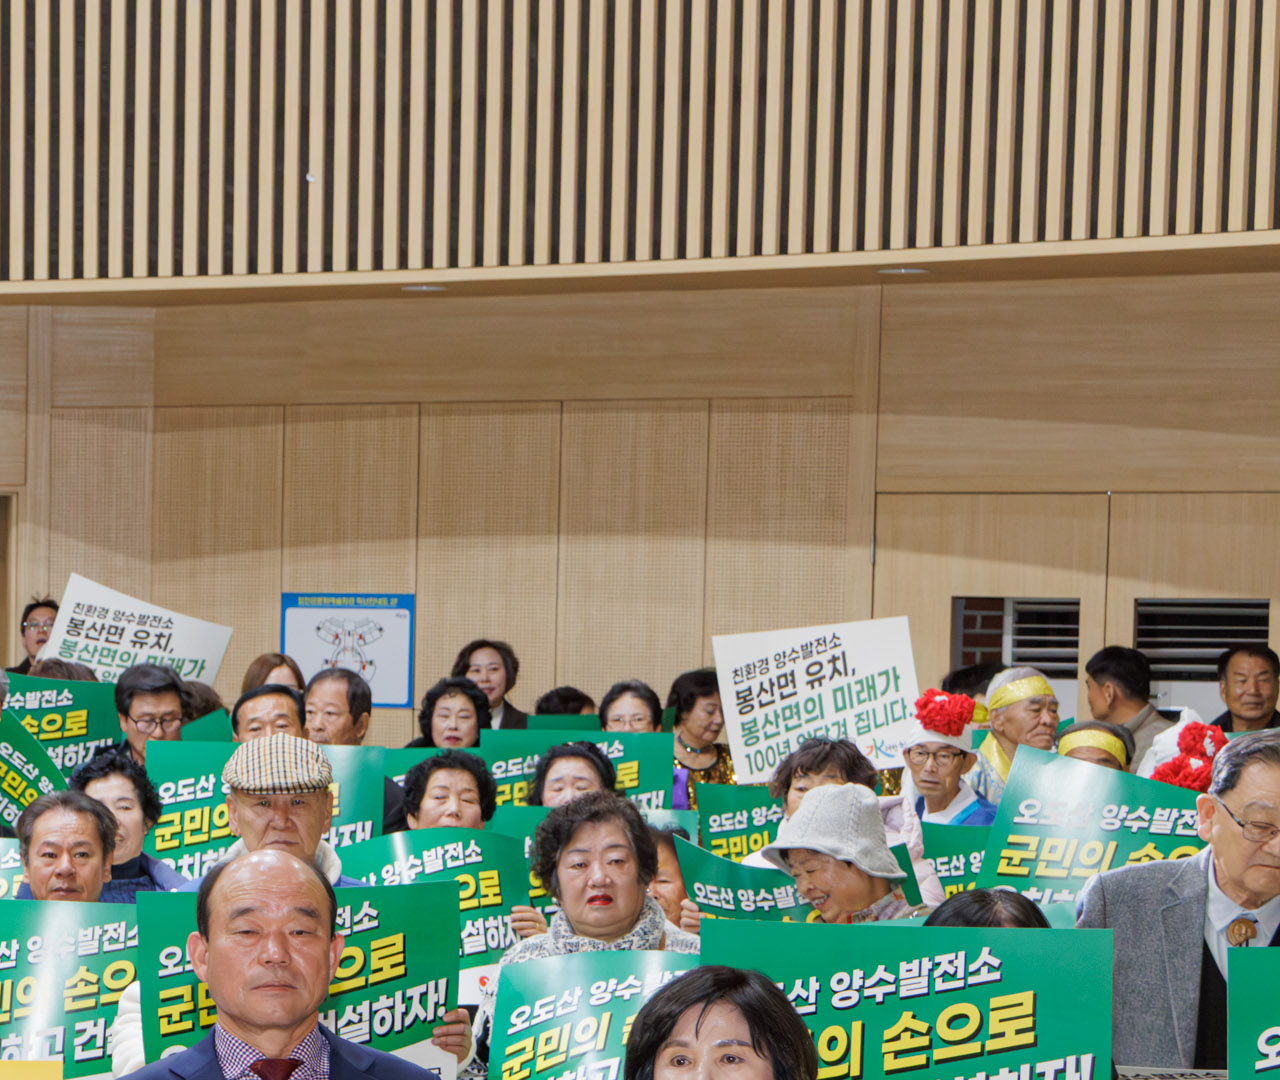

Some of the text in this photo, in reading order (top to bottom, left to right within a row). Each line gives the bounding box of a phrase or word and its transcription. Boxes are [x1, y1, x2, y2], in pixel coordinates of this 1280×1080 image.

[65, 617, 175, 654] 봉산면 유치,
[73, 602, 175, 631] 친환경 양수발전소
[58, 638, 137, 668] 봉산면의
[732, 632, 843, 686] 친환경 양수발전소
[735, 651, 857, 717] 봉산면 유치,
[741, 666, 901, 748] 봉산면의 미래가
[745, 697, 914, 776] 100년 집니다.
[159, 774, 216, 805] 오도산
[492, 754, 540, 780] 오도산
[154, 806, 234, 852] 군민의
[708, 811, 750, 834] 오도산
[381, 839, 484, 886] 양수발전소
[710, 831, 771, 864] 군민의
[997, 834, 1118, 880] 군민의
[693, 882, 736, 911] 오도산
[829, 946, 1004, 1011] 양수발전소
[507, 986, 585, 1037] 오도산
[881, 990, 1038, 1075] 손으로
